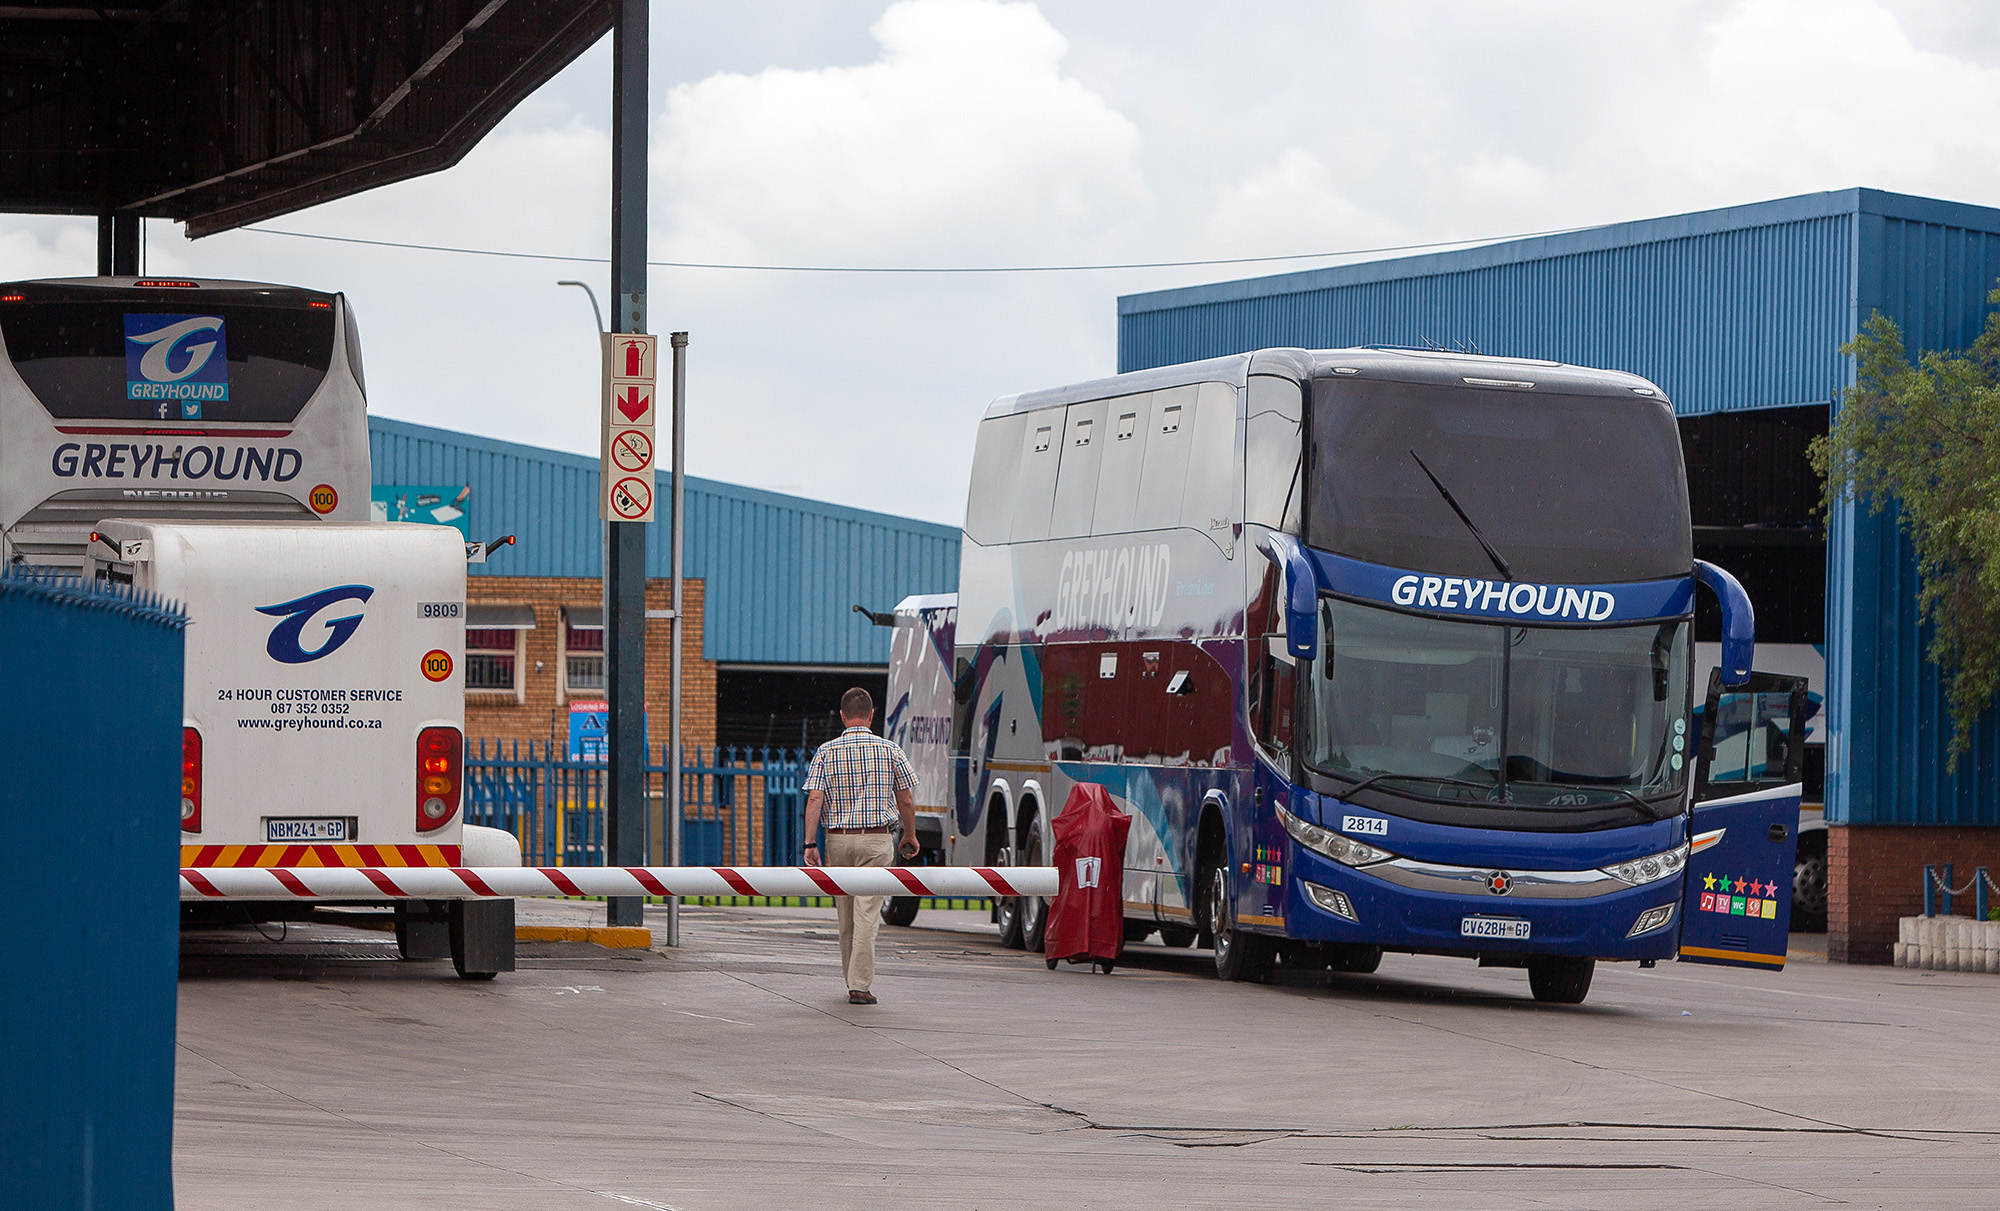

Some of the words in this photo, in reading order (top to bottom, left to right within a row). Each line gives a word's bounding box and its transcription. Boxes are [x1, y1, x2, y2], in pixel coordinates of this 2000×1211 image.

[131, 383, 225, 399] GREYHOUND
[51, 443, 303, 483] GREYHOUND
[313, 490, 334, 507] 100
[1056, 543, 1171, 631] GREYHOUND
[1391, 575, 1615, 621] GREYHOUND
[423, 604, 459, 618] 9809
[426, 659, 448, 673] 100
[218, 689, 232, 701] 24
[236, 689, 272, 701] HOUR
[276, 689, 346, 701] CUSTOMER
[350, 690, 403, 702] SERVICE
[271, 703, 292, 714] 087
[296, 703, 318, 714] 352
[321, 703, 350, 714] 0352
[237, 716, 382, 731] www.greyhound.co.za
[270, 822, 317, 838] NBM241
[326, 823, 343, 837] GP
[1347, 817, 1383, 833] 2814
[1718, 897, 1729, 906] TV
[1733, 901, 1744, 910] WC
[1462, 920, 1507, 936] CV62BH
[1515, 922, 1530, 937] GP
